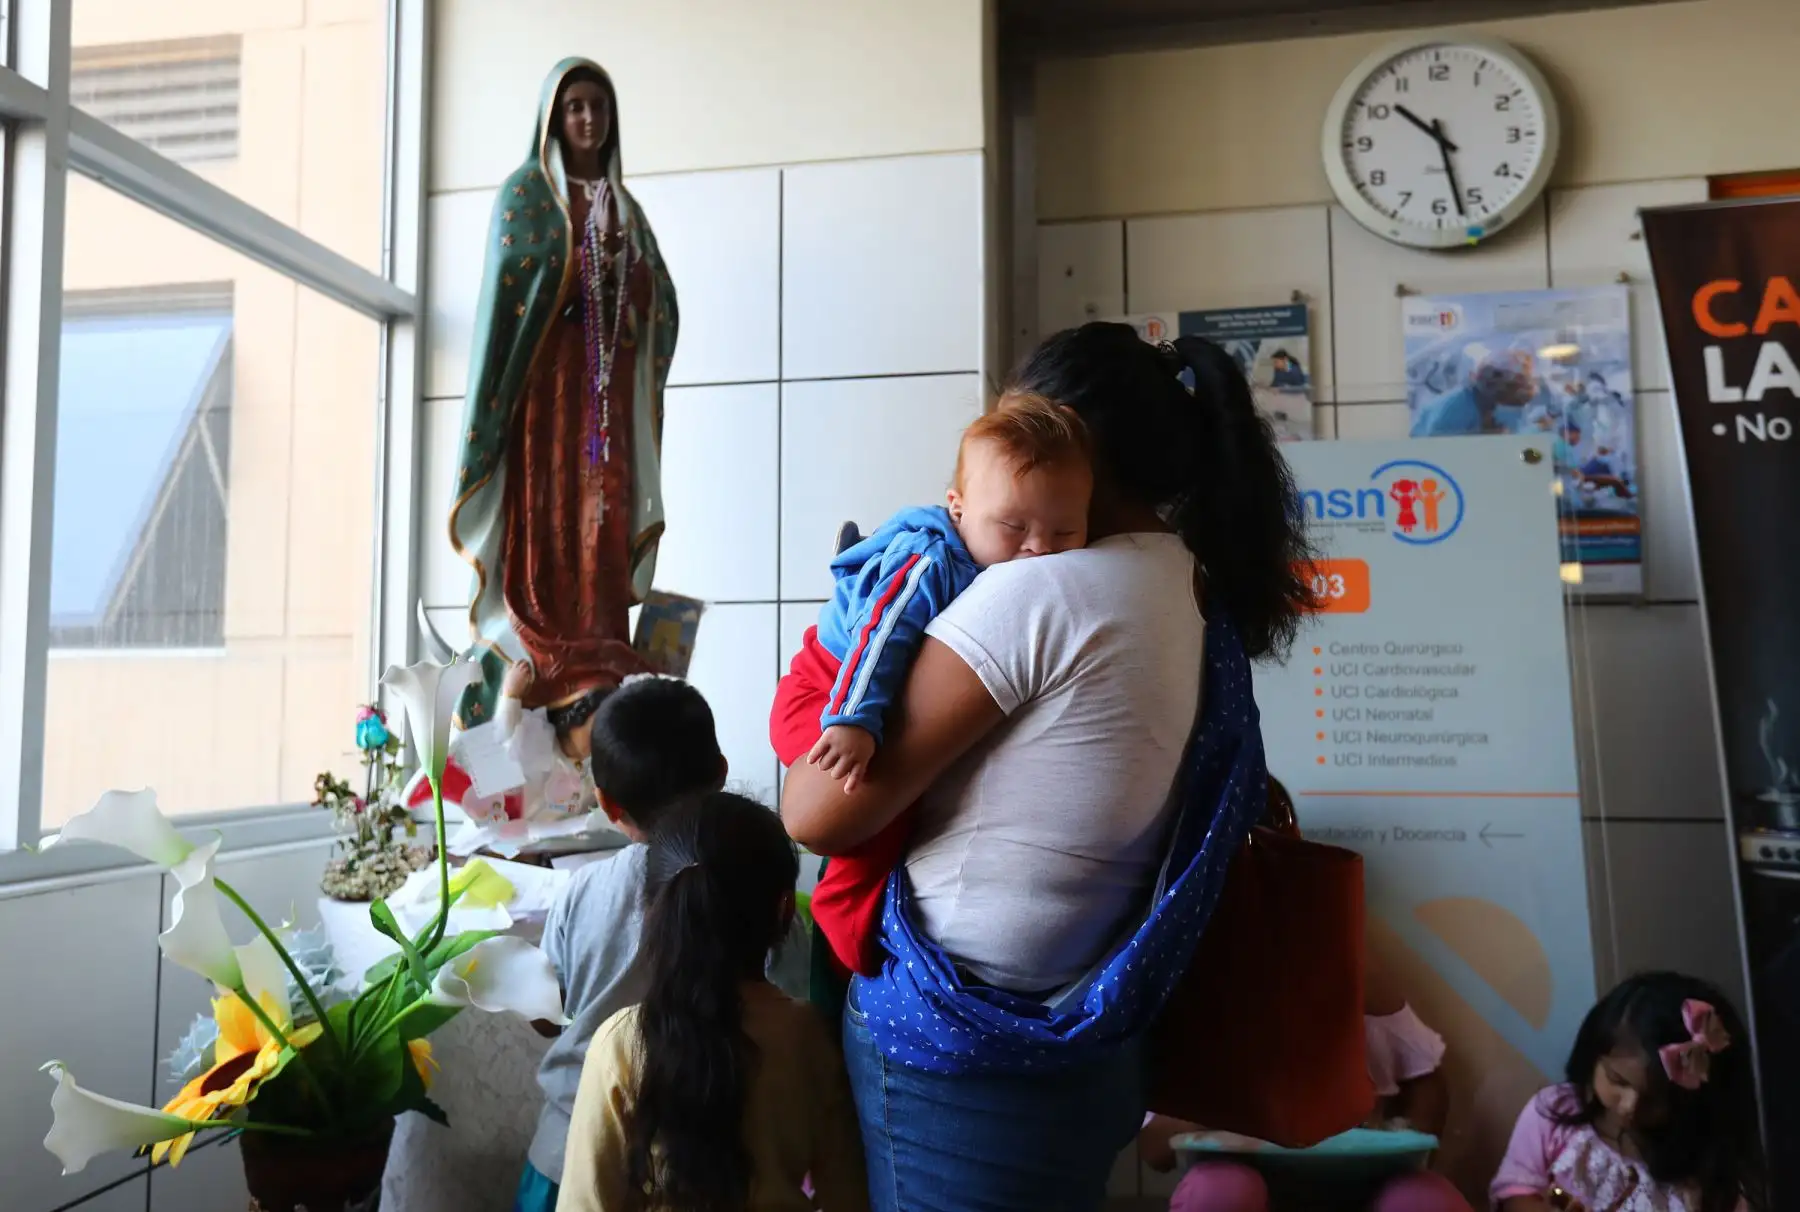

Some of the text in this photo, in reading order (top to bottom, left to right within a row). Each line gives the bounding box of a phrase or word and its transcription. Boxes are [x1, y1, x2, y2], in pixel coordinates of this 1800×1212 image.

[1429, 64, 1450, 81] 12
[1473, 71, 1481, 87] 1
[1396, 77, 1408, 92] 11
[1494, 95, 1510, 111] 2
[1367, 104, 1390, 120] 10
[1357, 136, 1373, 151] 9
[1506, 127, 1520, 144] 3
[1370, 170, 1386, 186] 8
[1494, 163, 1510, 178] 4
[1398, 191, 1413, 208] 7
[1466, 188, 1482, 204] 5
[1431, 200, 1447, 215] 6
[1691, 275, 1800, 338] CA
[1703, 341, 1800, 403] LA
[1735, 412, 1792, 443] No
[1288, 488, 1385, 519] nsn
[1311, 573, 1346, 599] 03
[1329, 641, 1463, 658] Centro Quirúrgico
[1330, 662, 1476, 677] UCI Cardiovascular
[1331, 684, 1458, 701] UCI Cardiológica
[1332, 707, 1434, 721] UCI Neonatal
[1333, 729, 1489, 746] UCI Neuroquirúrgica
[1334, 752, 1457, 767] UCI Intermedios
[1378, 829, 1386, 845] y
[1393, 826, 1467, 842] Docencia
